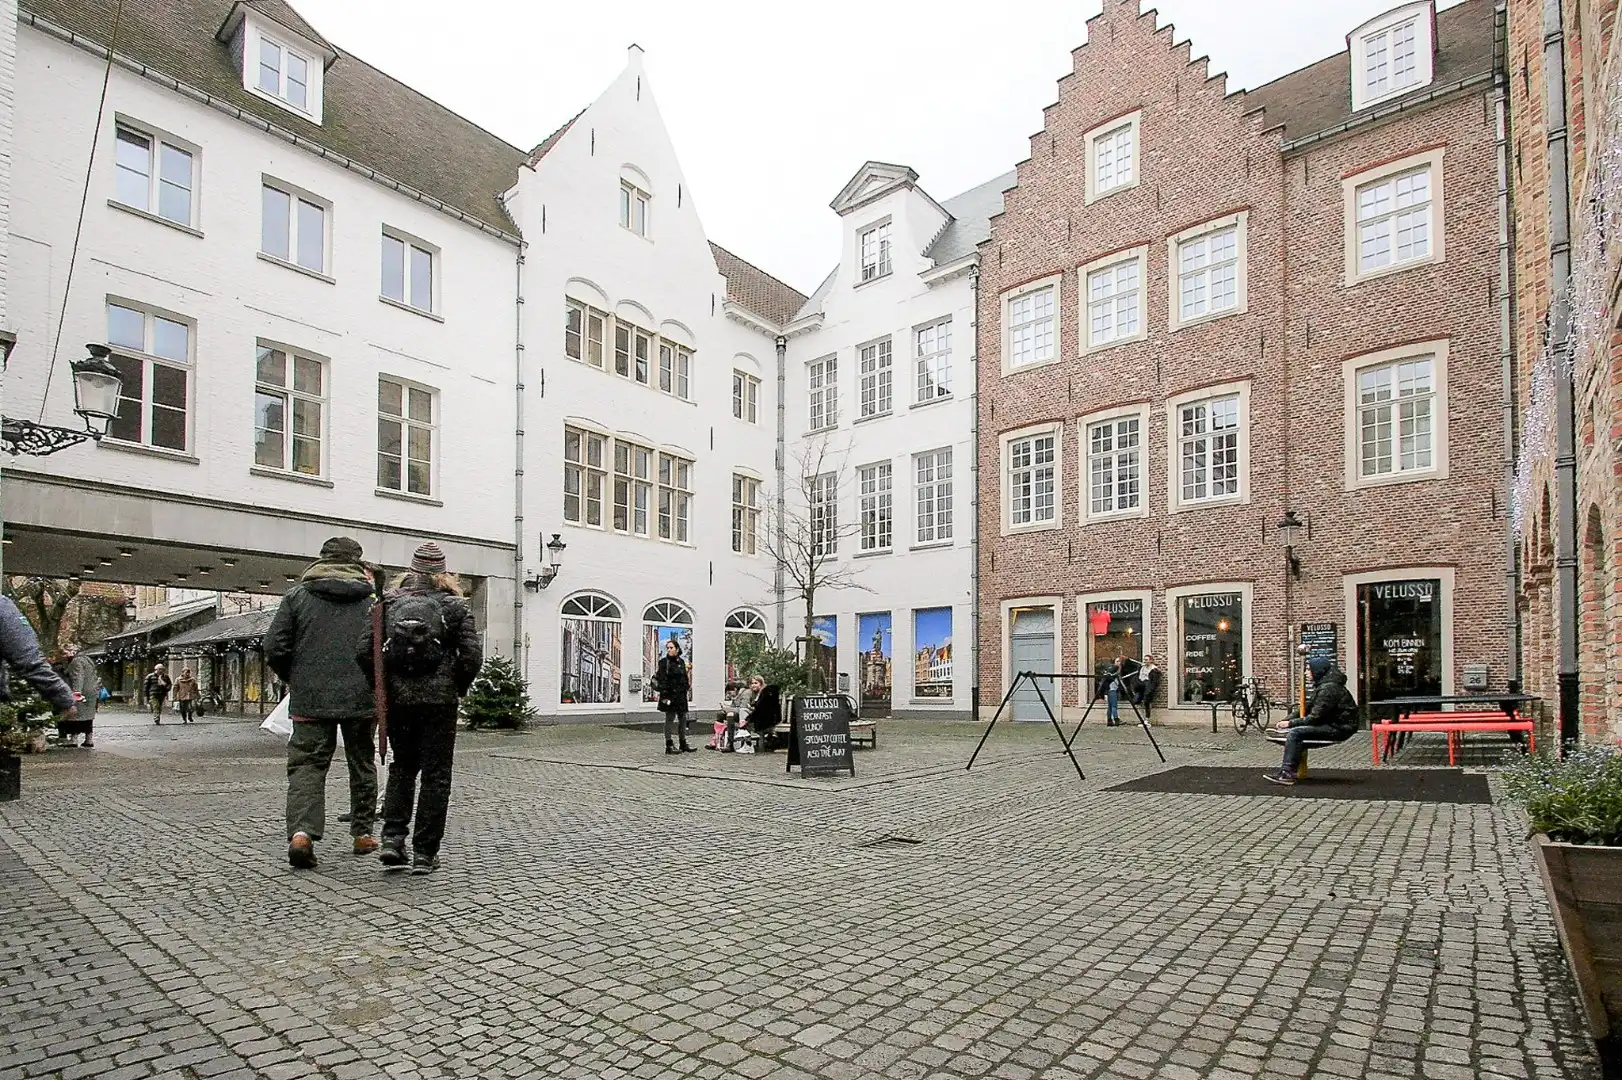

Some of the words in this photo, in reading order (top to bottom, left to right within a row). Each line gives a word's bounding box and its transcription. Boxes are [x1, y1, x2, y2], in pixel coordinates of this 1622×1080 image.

[1375, 582, 1433, 599] VELUSSO
[1185, 633, 1217, 641] COFFEE
[1383, 639, 1400, 648] KOM
[1185, 650, 1204, 658] RIDE
[1469, 676, 1481, 684] 26
[803, 698, 839, 708] VELUSSO
